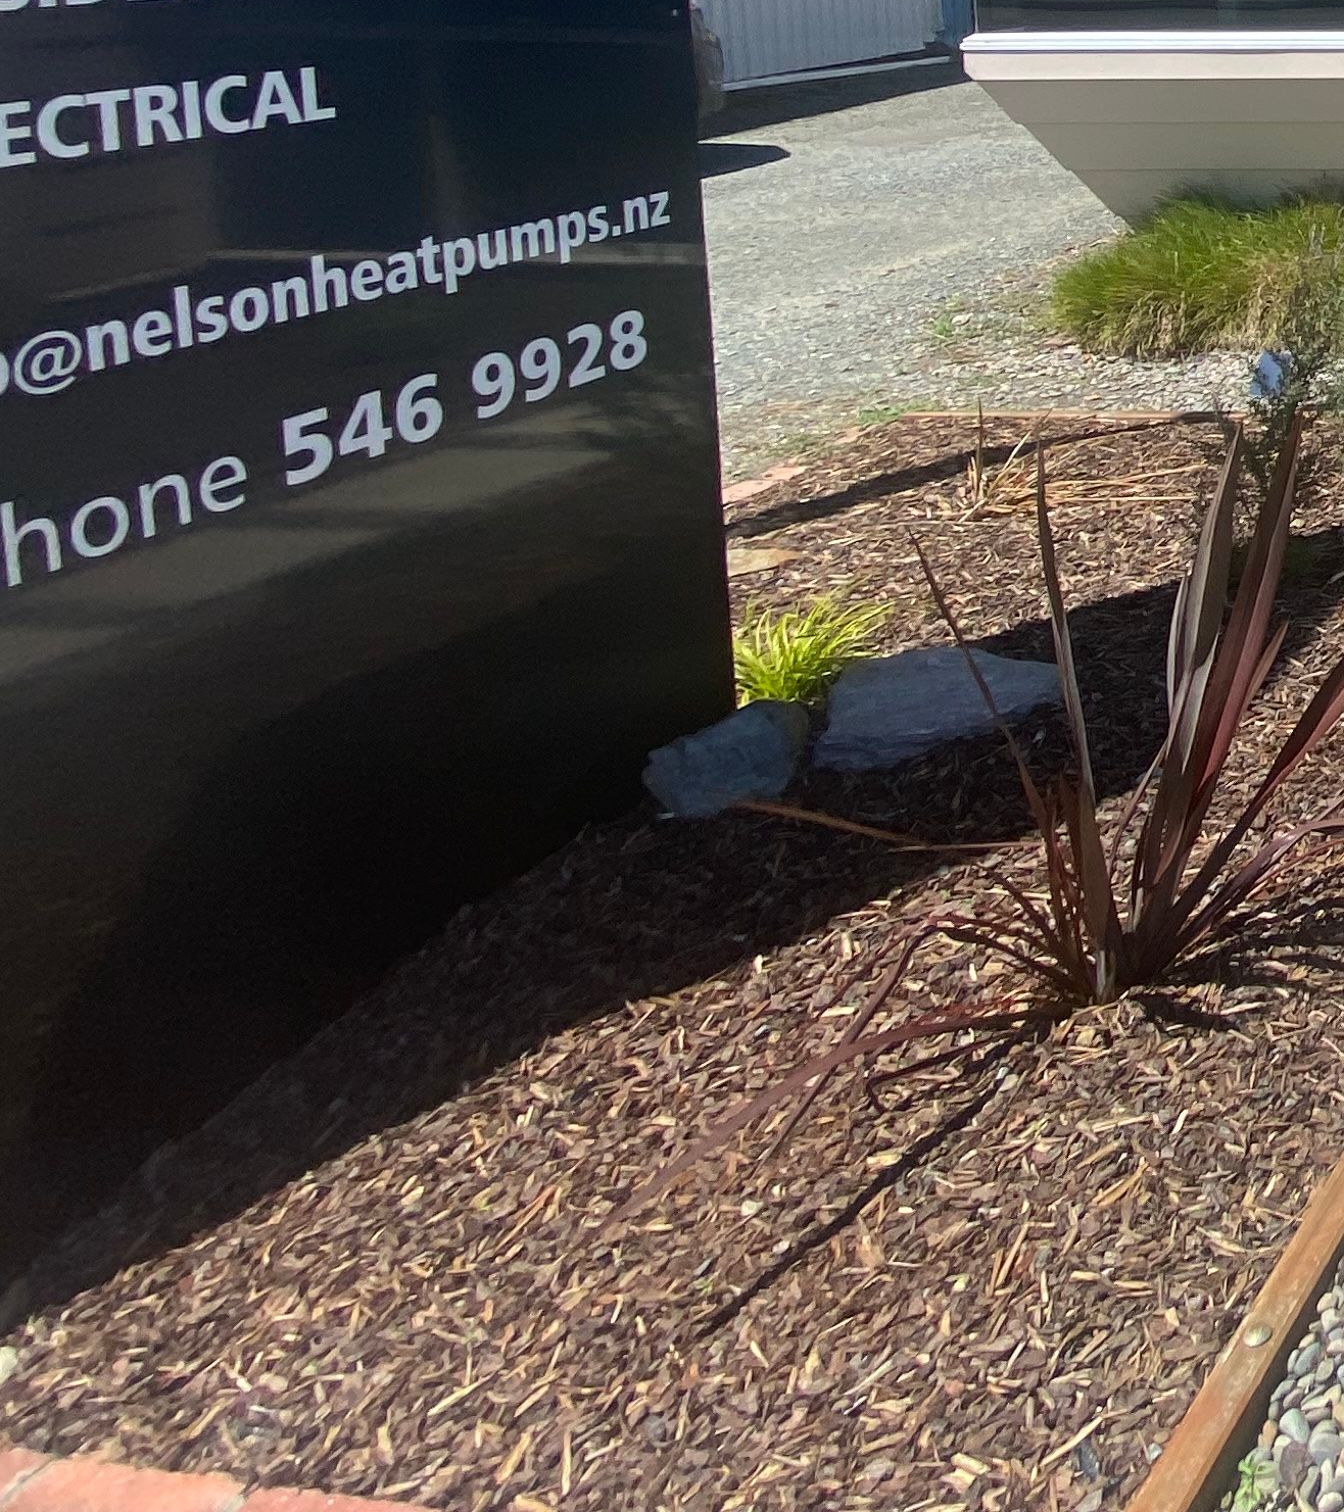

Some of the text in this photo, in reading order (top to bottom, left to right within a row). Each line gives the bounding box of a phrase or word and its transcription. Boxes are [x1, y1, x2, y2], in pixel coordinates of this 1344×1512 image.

[0, 190, 671, 396] @nelsonheatpumps.nz
[282, 372, 444, 486] 546
[471, 309, 647, 420] 9928
